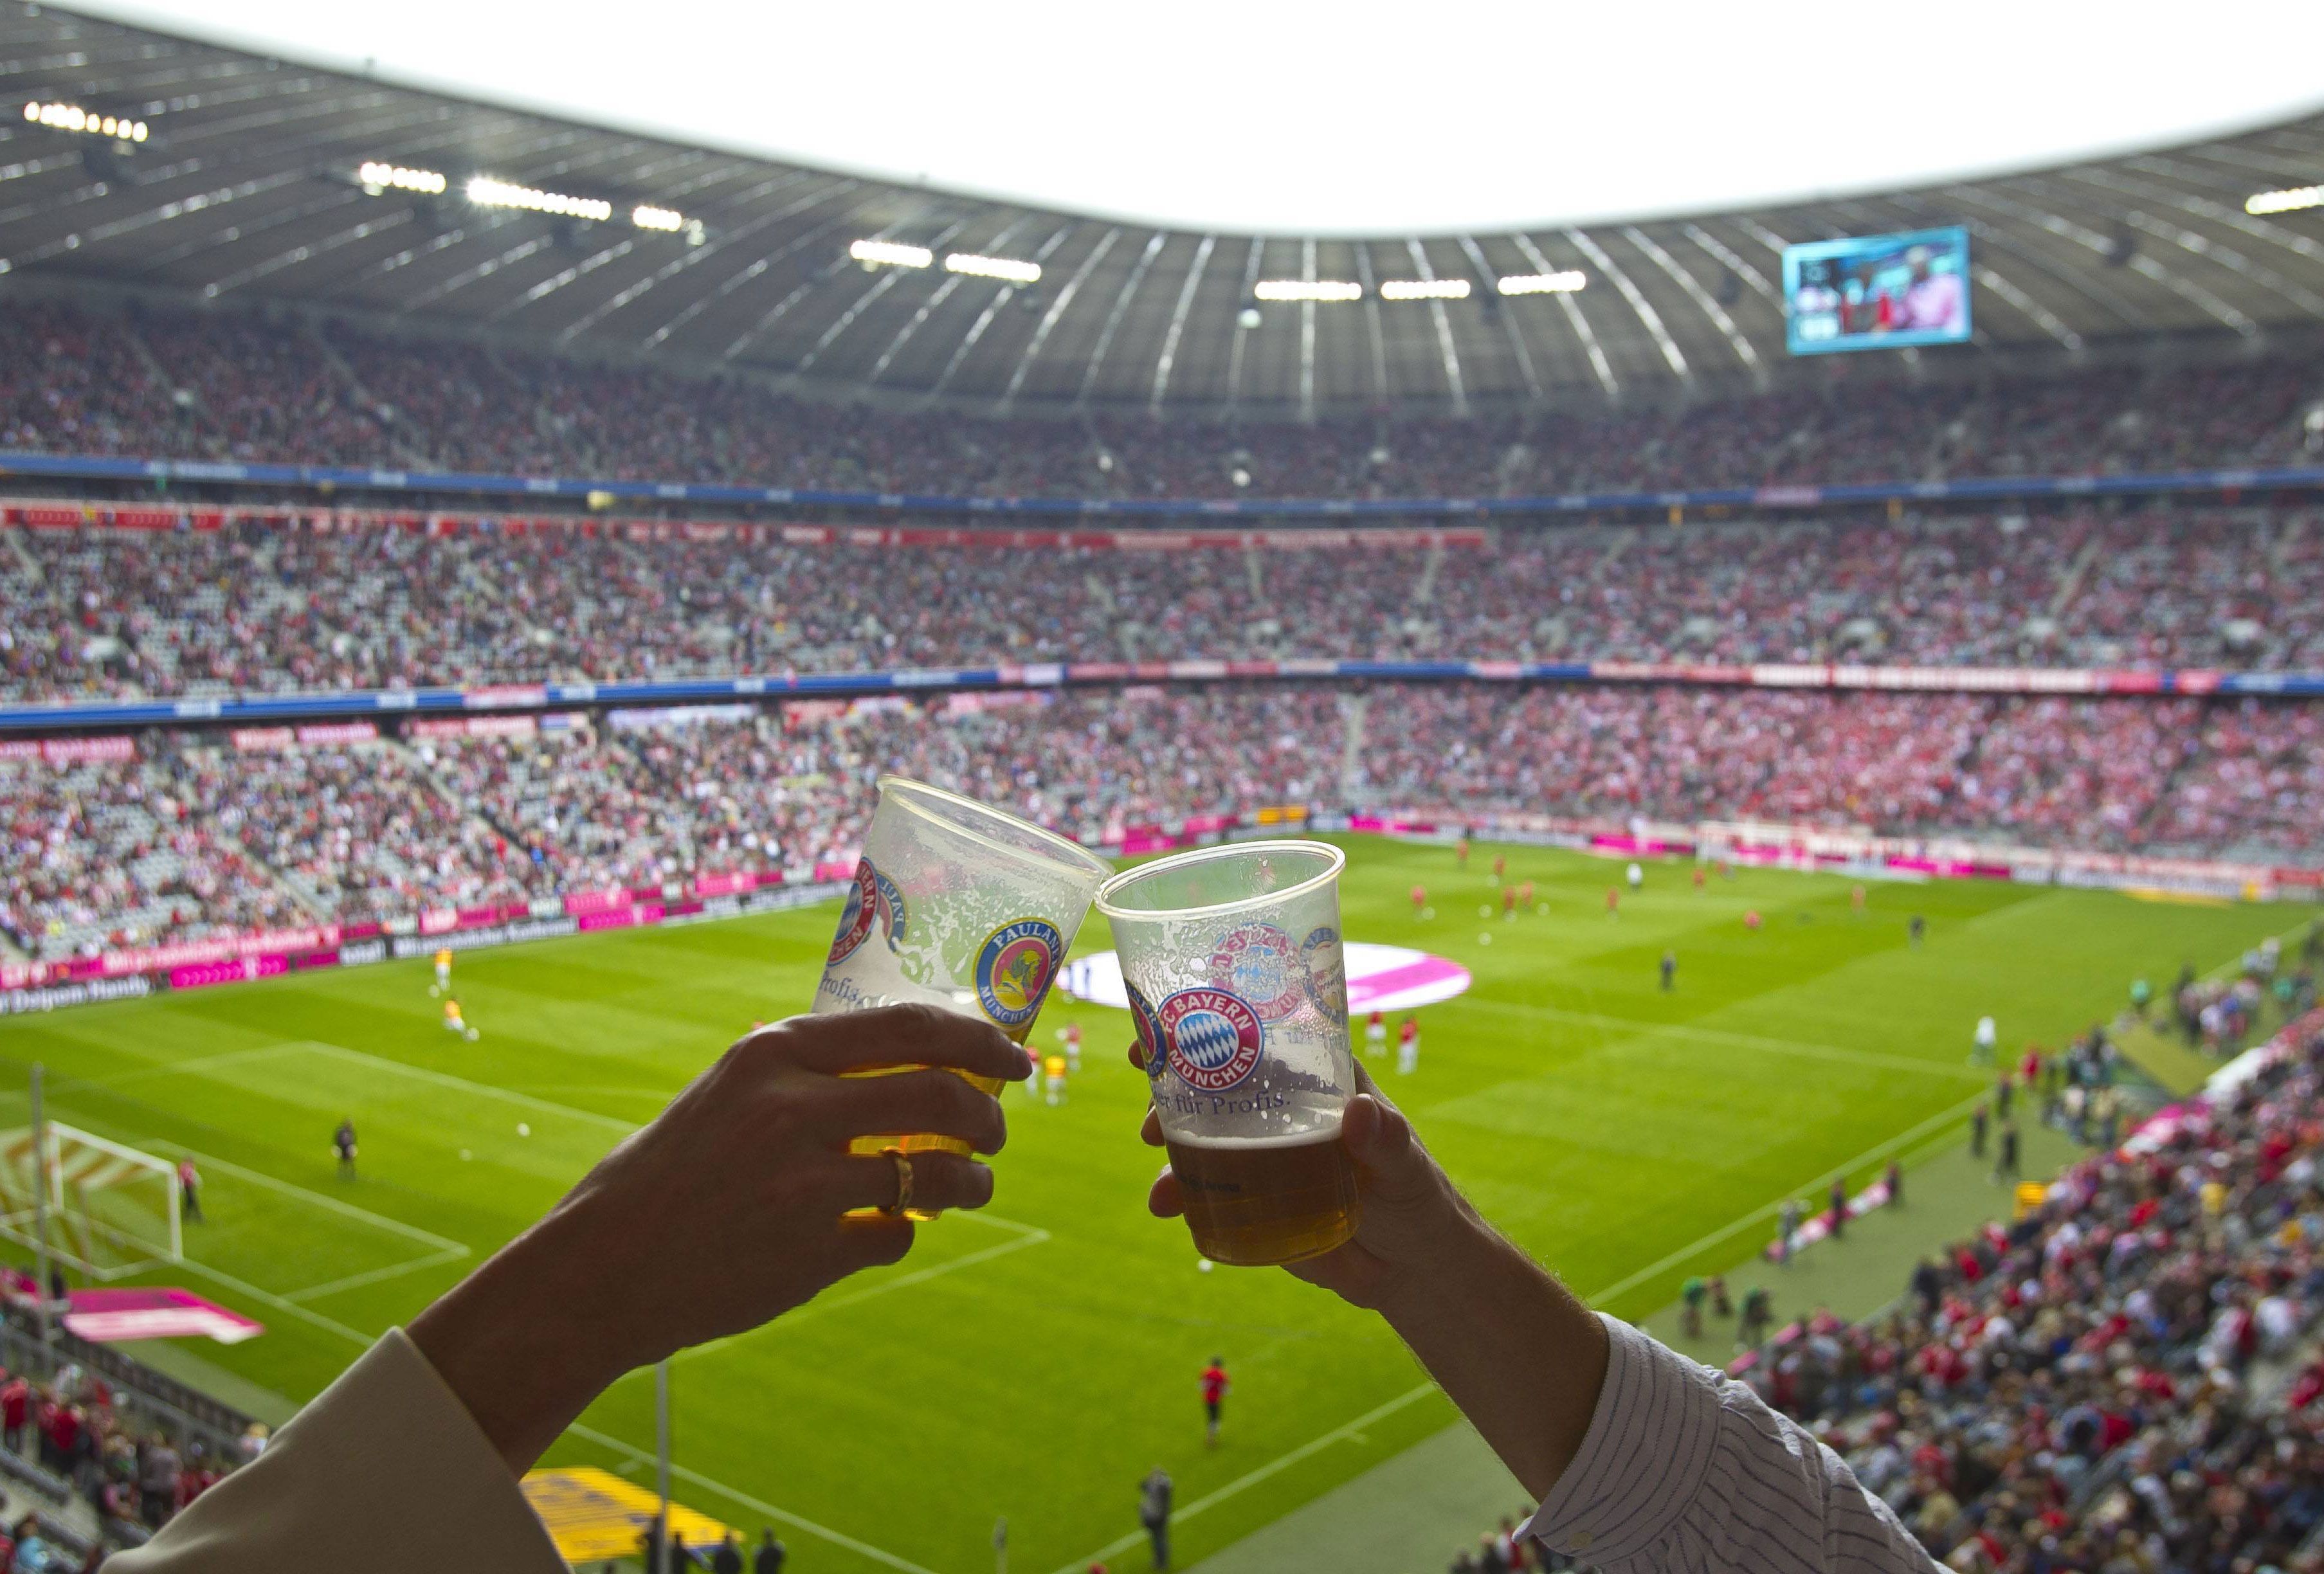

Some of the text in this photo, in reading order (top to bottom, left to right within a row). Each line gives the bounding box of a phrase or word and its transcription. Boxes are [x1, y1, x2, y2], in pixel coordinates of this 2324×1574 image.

[1173, 993, 1252, 1030] BAYERN
[1176, 1094, 1203, 1114] für
[1212, 1090, 1290, 1115] Profis.
